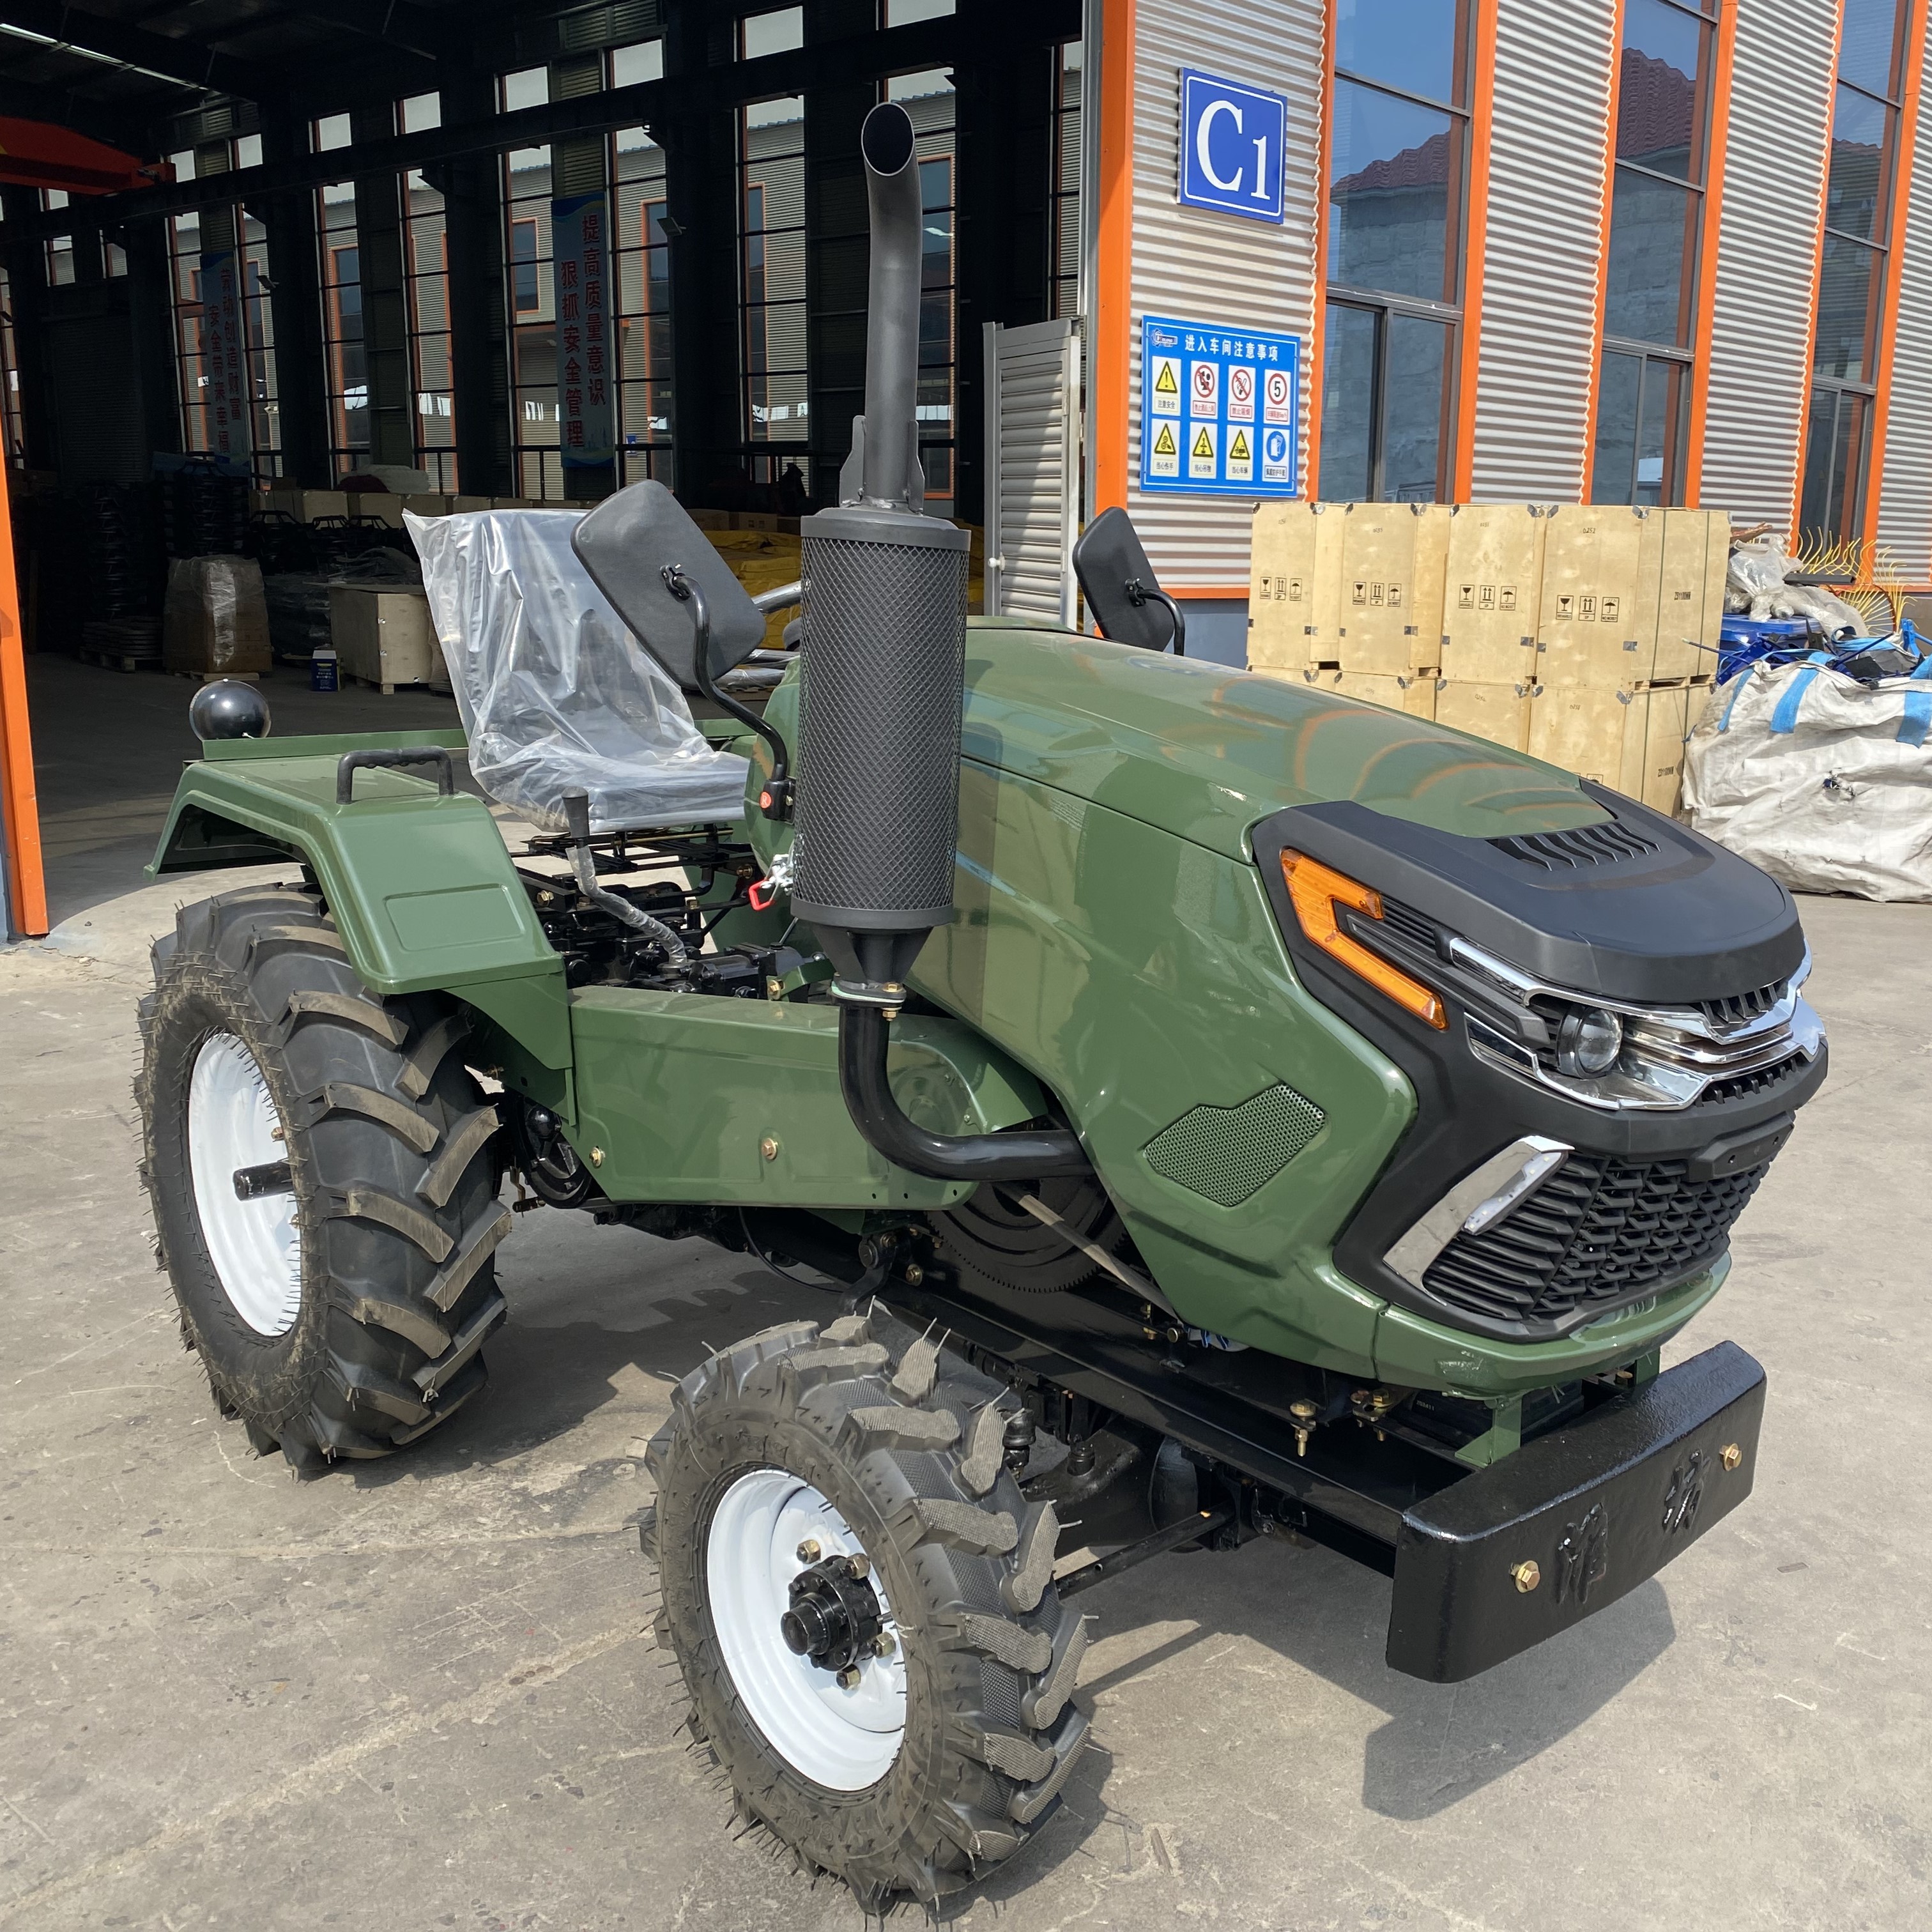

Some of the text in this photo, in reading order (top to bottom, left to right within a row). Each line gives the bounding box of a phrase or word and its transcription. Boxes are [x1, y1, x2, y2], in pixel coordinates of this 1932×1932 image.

[1197, 100, 1271, 201] C1
[209, 304, 231, 453] 安全带来幸福
[220, 268, 241, 421] 劳动创造财富
[561, 260, 585, 448] 狠抓安全管理
[582, 214, 606, 406] 提高质量意识
[1184, 334, 1278, 362] 进入车间注意事项
[1274, 381, 1281, 397] 5
